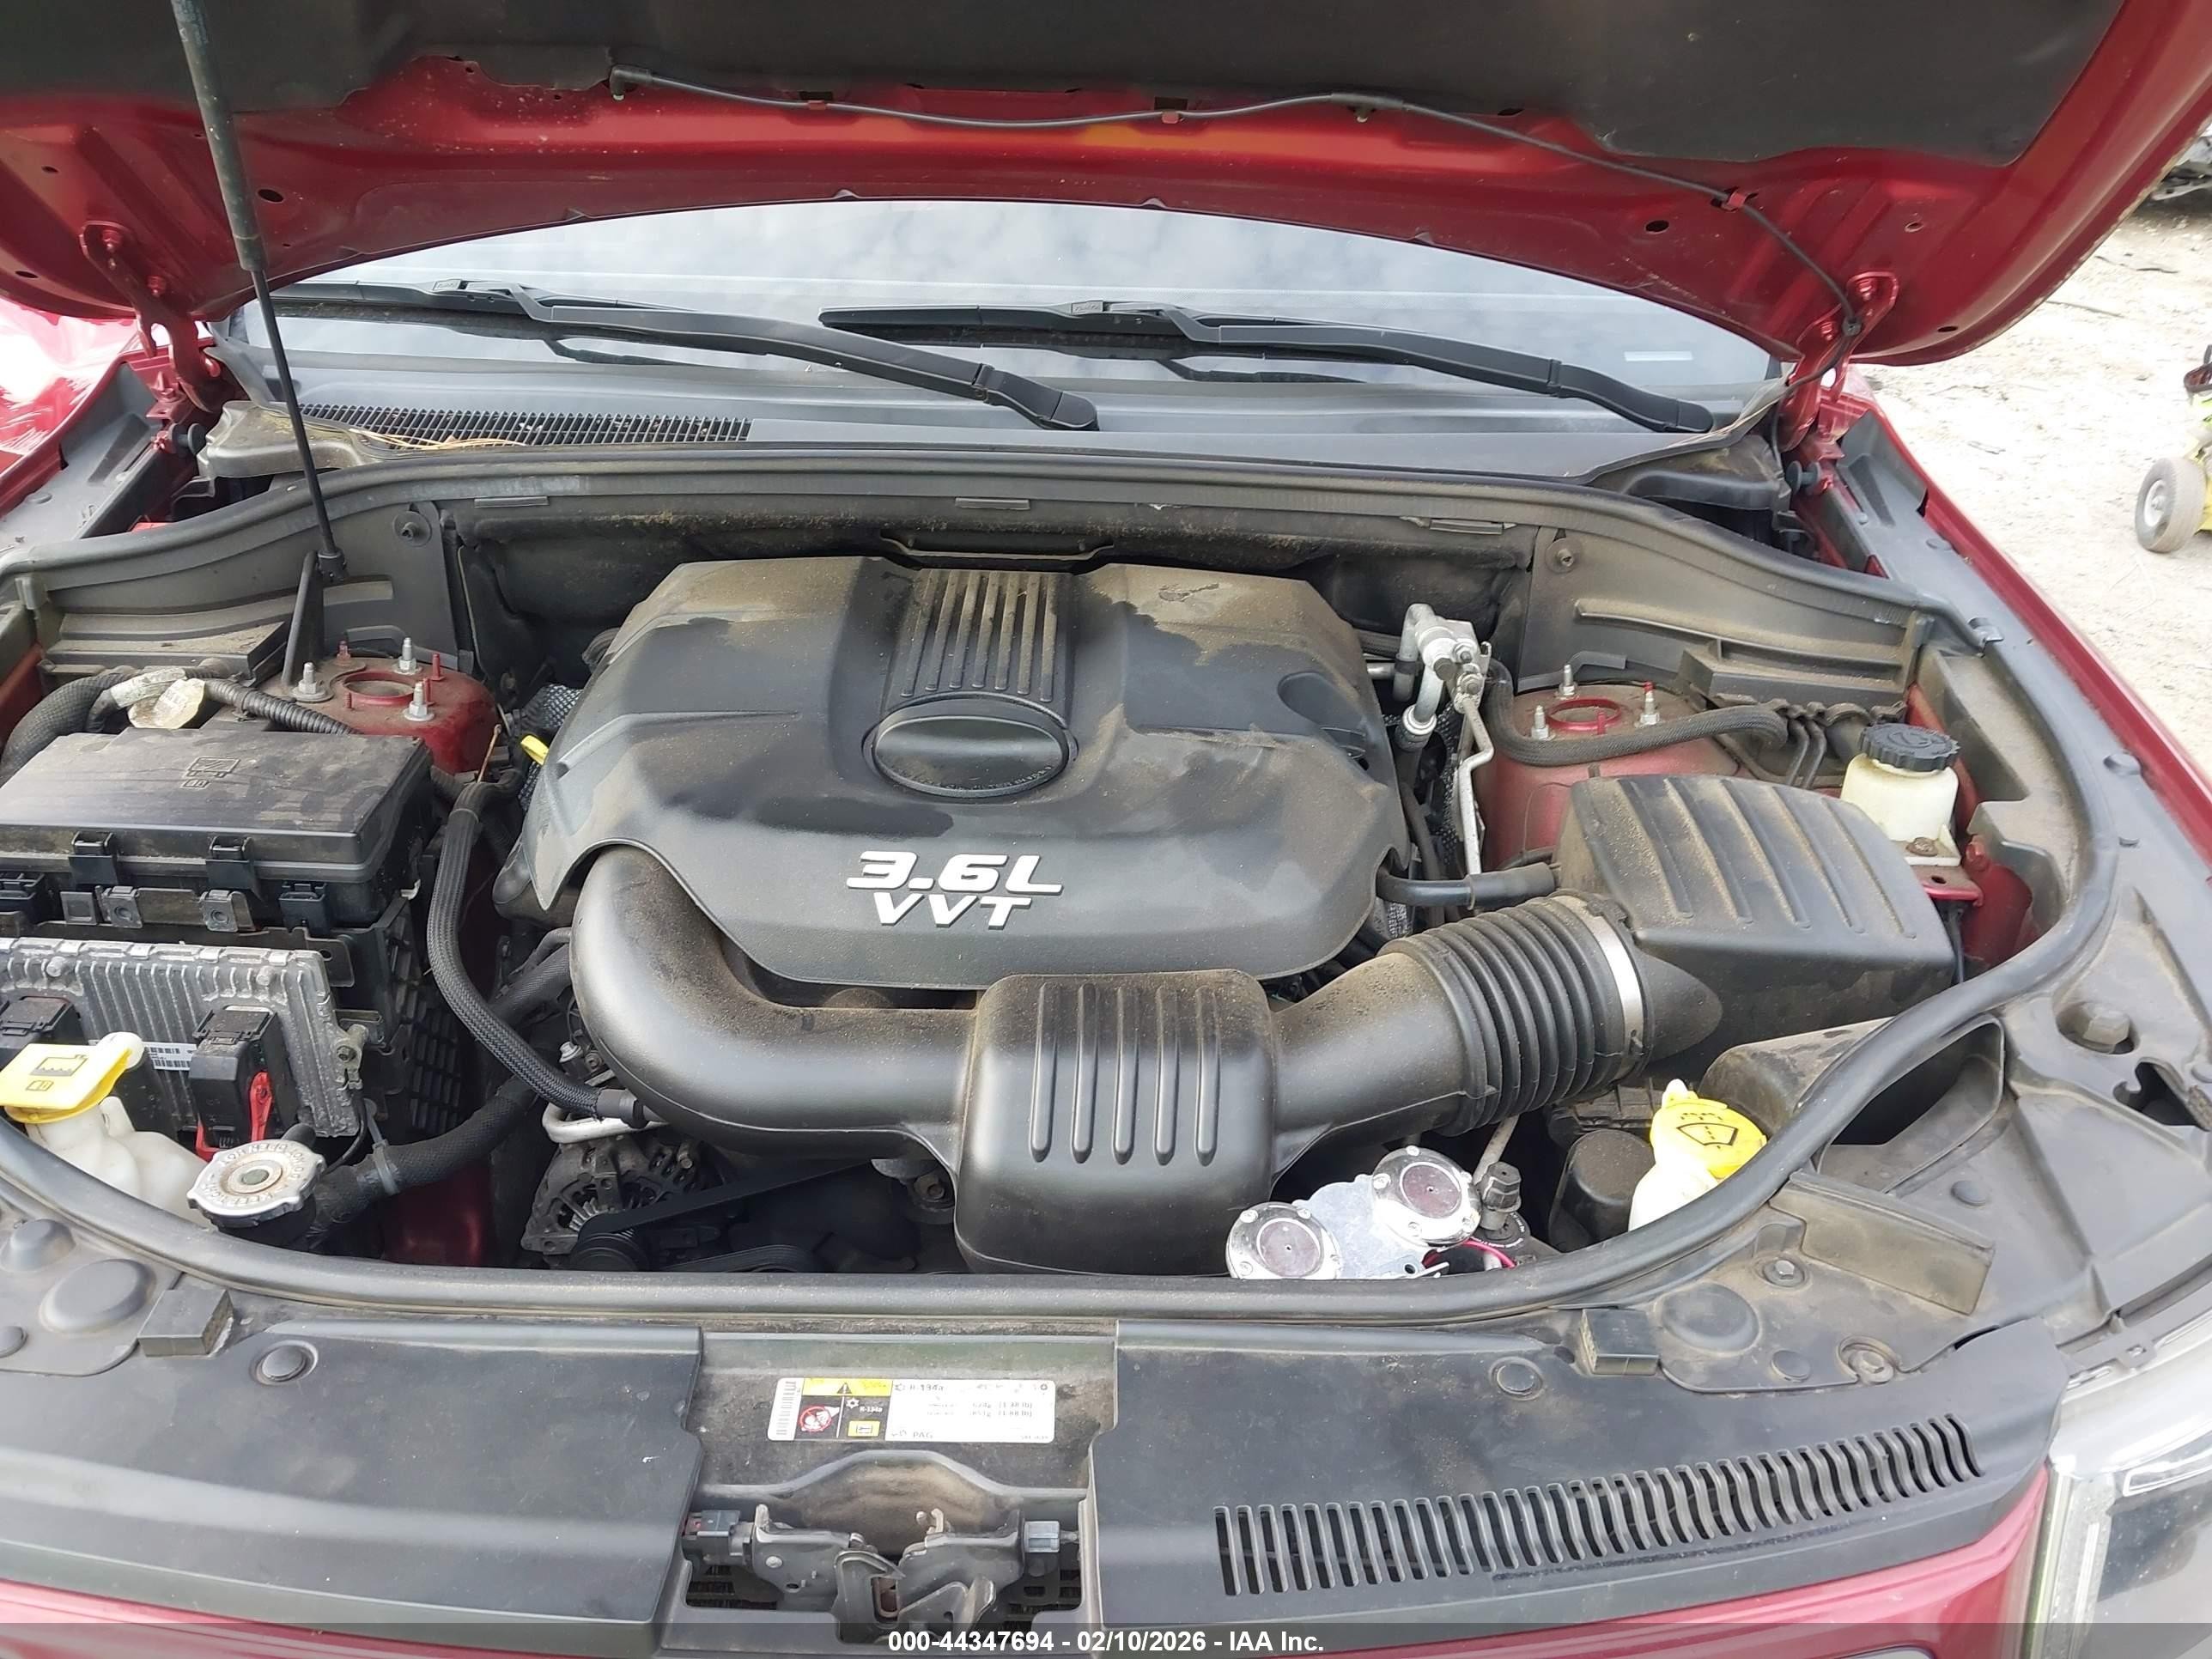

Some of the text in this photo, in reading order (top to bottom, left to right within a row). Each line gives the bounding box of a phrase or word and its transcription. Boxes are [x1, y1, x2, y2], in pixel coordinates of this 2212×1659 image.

[846, 851, 1063, 896] 3.6L
[873, 892, 1032, 930] VVT
[248, 1143, 289, 1153] OPEN
